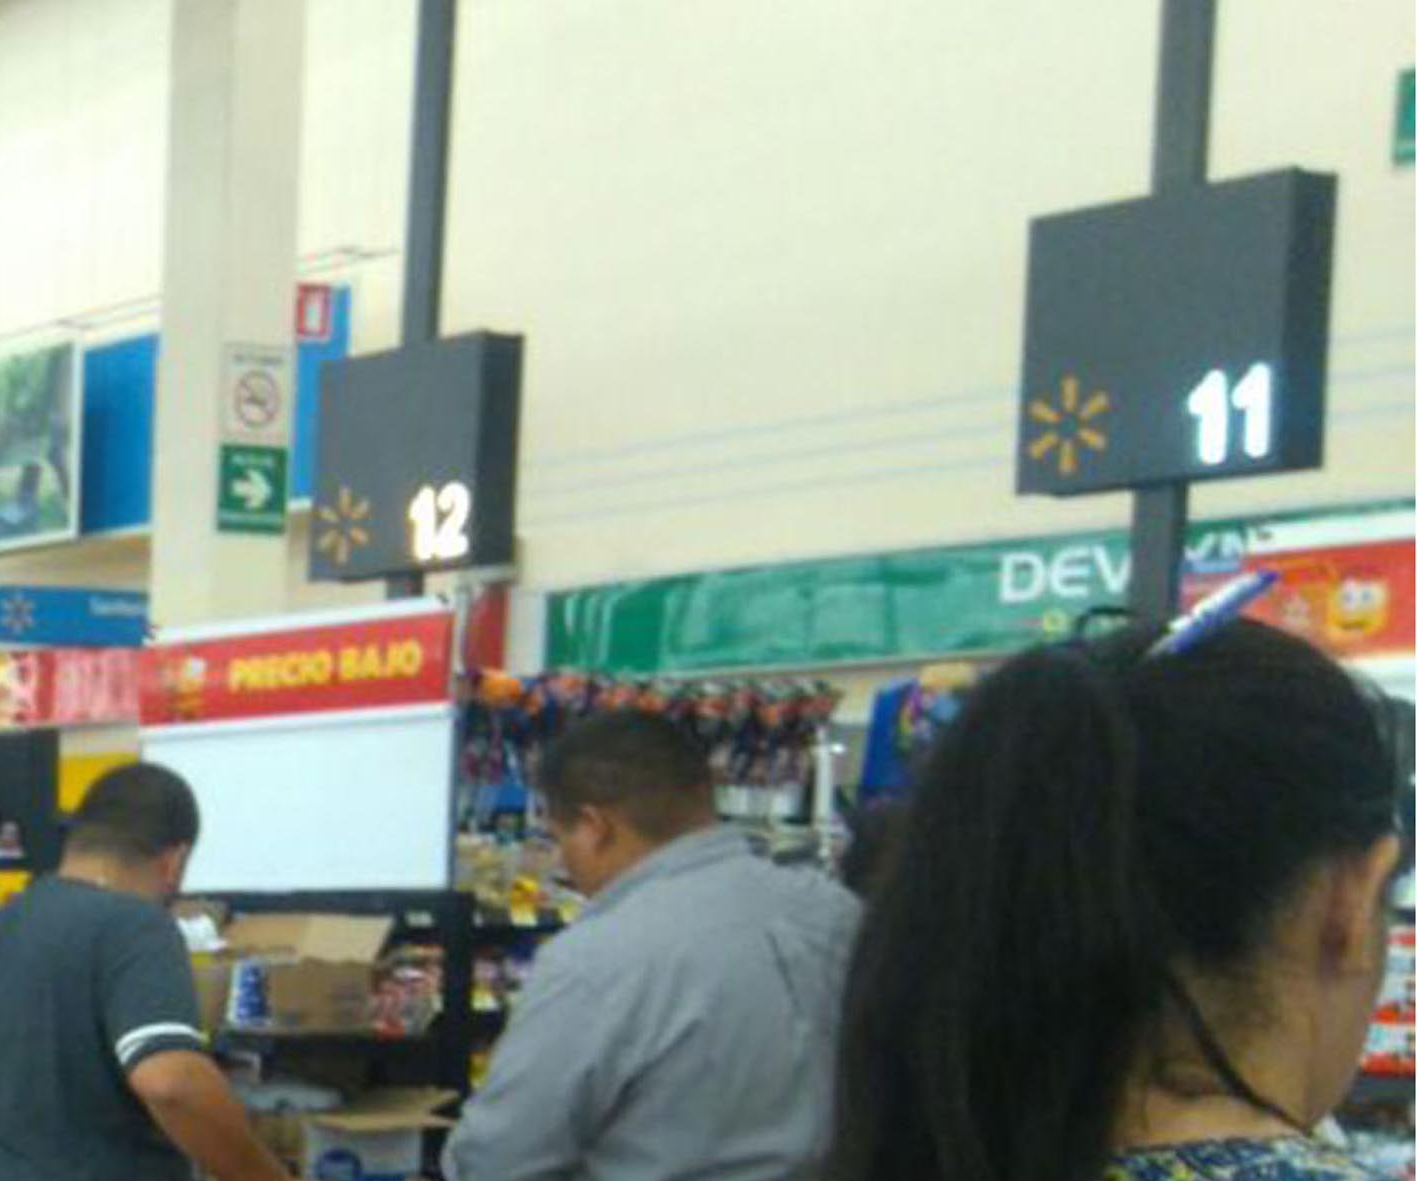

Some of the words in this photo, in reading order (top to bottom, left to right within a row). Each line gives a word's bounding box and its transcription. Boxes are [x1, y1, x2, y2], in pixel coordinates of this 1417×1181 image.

[1187, 362, 1269, 463] 11
[409, 481, 470, 561] 12
[229, 650, 333, 692] PRECIO
[339, 638, 422, 680] BAJO
